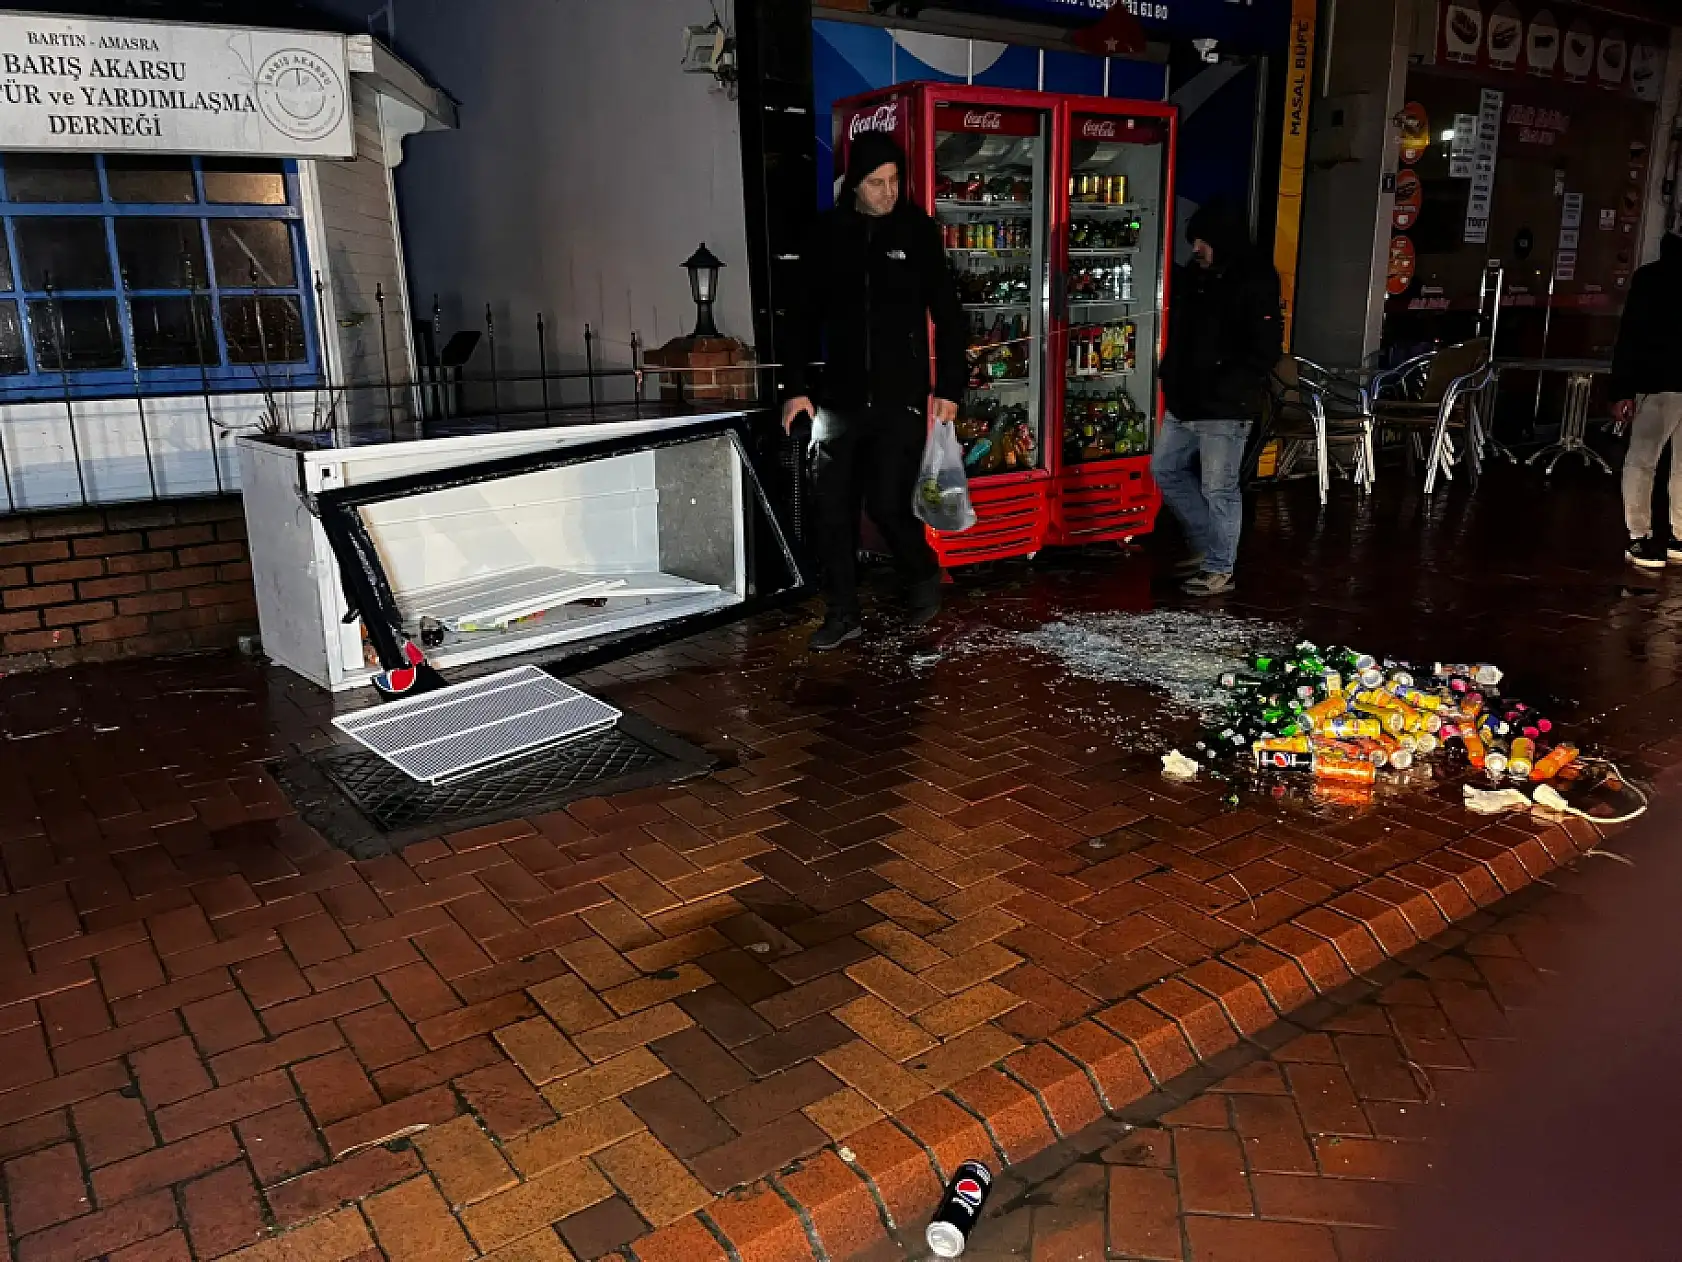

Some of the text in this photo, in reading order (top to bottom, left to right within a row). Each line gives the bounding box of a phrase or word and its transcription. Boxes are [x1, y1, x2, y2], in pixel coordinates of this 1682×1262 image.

[26, 31, 86, 47] BARTIN
[99, 36, 160, 52] AMASRA
[2, 53, 187, 81] BARIŞ AKARSU
[1289, 20, 1309, 136] MASAL BÜFE
[0, 79, 258, 115] ÜR ve YARDIMLAŞMA
[48, 114, 163, 137] DERNEĞİ
